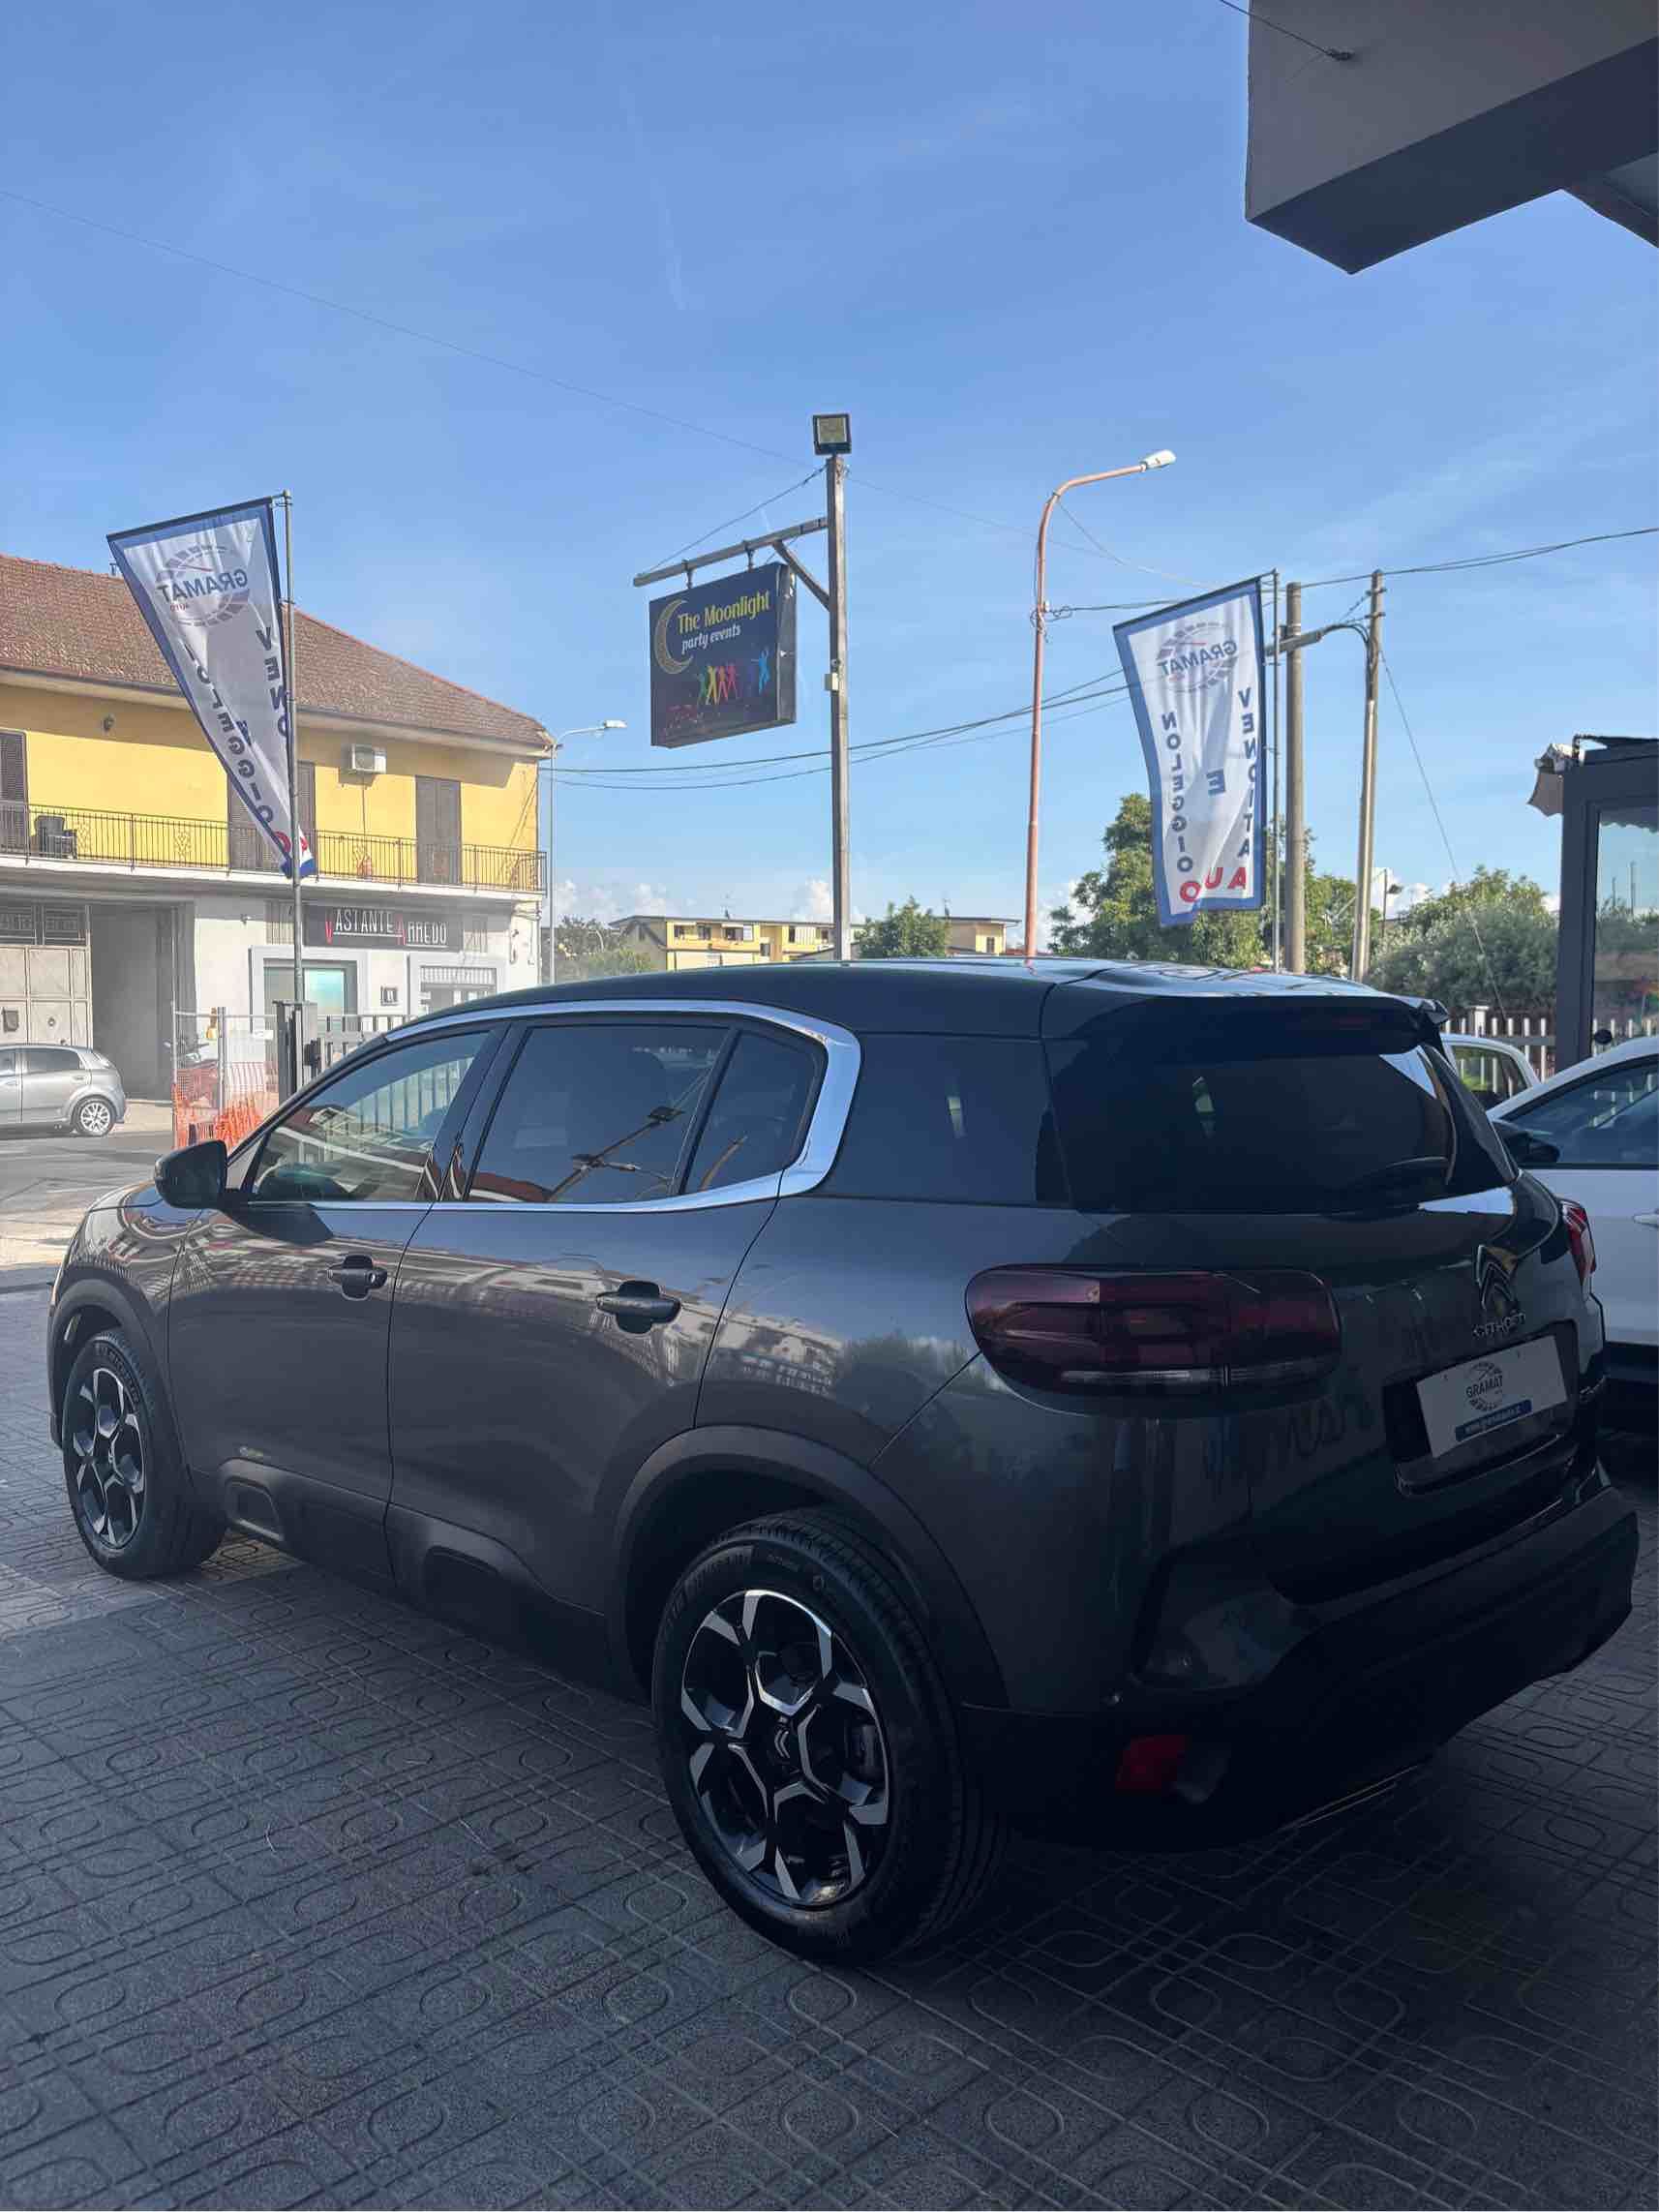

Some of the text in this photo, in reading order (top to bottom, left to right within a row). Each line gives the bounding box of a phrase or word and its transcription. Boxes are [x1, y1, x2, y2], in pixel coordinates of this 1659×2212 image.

[679, 591, 769, 634] The Moonlight
[681, 624, 741, 654] party events
[1465, 1375, 1503, 1398] GRAMAT
